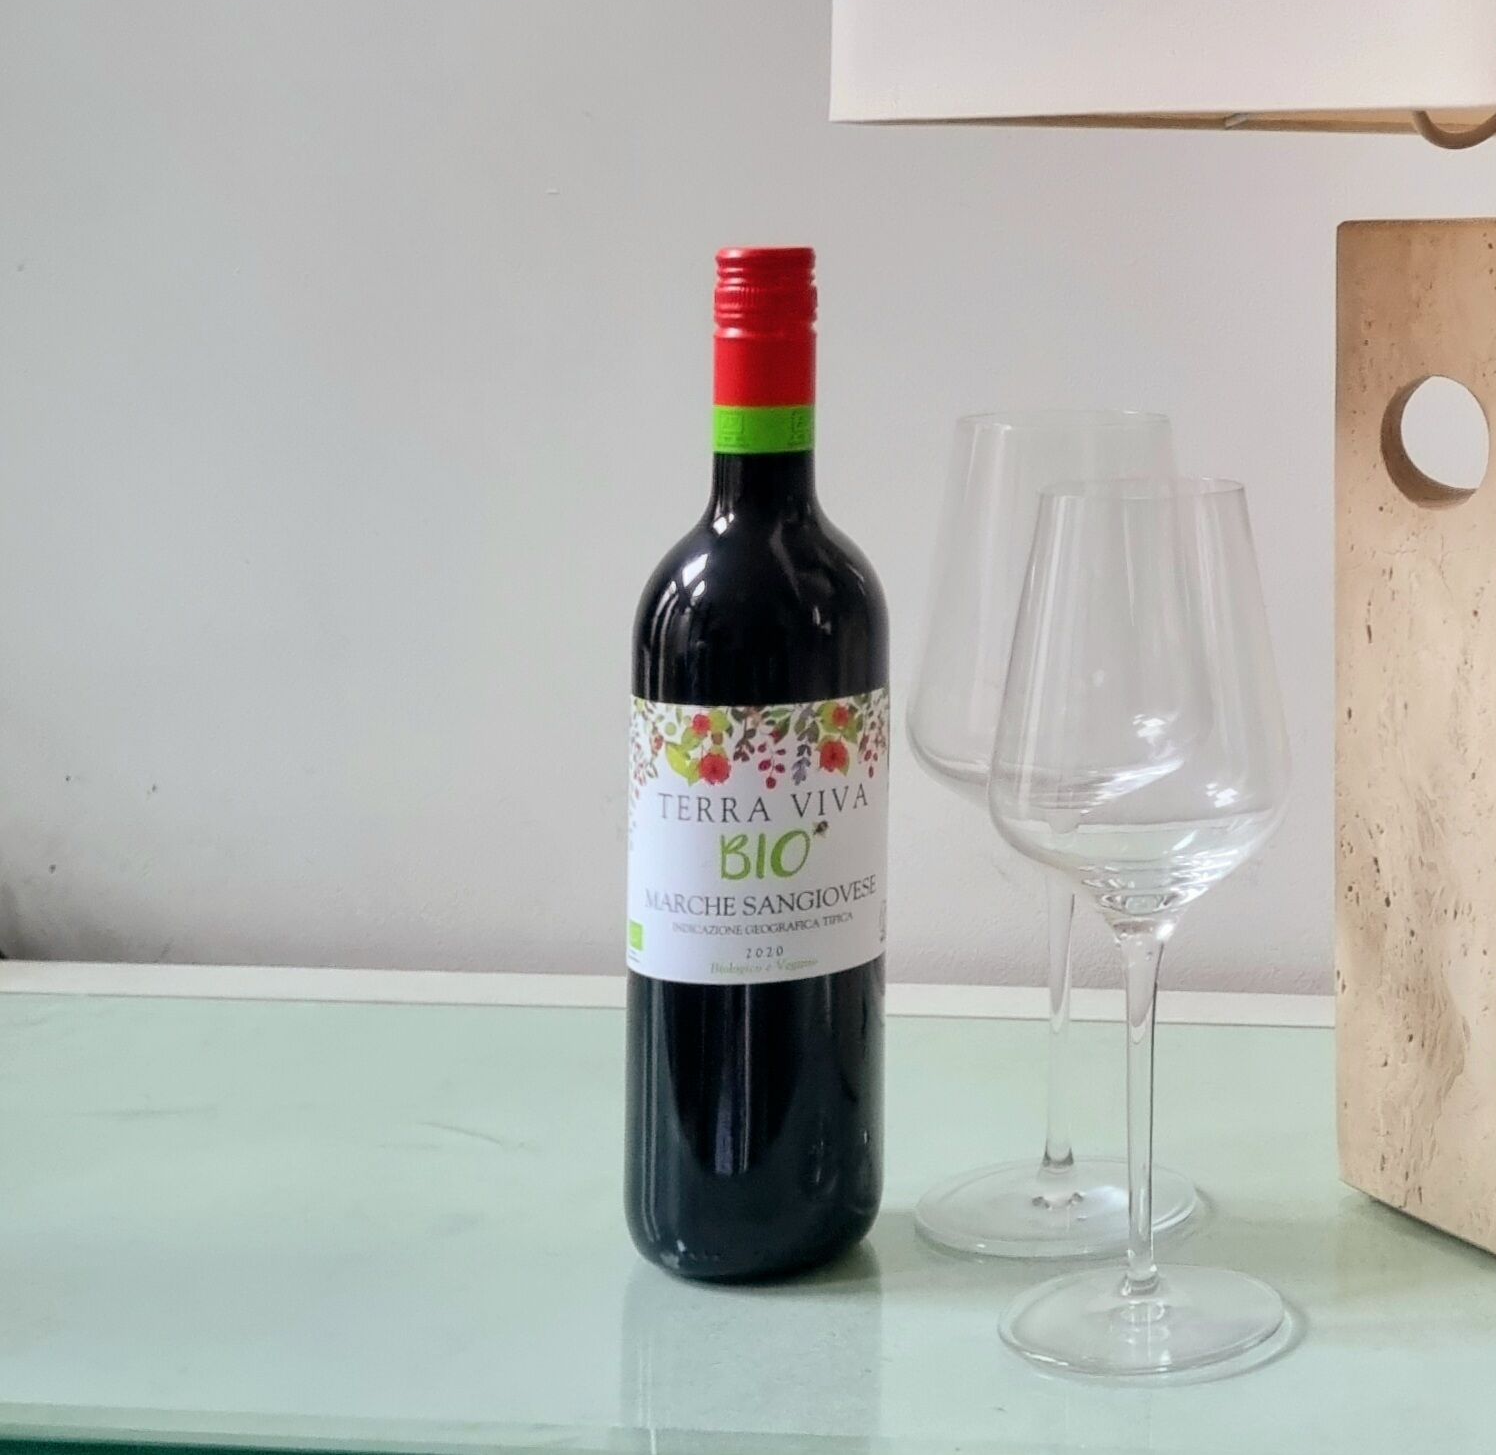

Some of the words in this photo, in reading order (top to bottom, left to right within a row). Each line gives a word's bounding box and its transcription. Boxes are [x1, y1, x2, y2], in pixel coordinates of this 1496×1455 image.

[658, 792, 771, 823] TERRA
[790, 783, 868, 819] VIVA
[719, 829, 811, 881] BIO
[645, 888, 737, 917] MARCHE
[742, 874, 877, 917] SANGIOVESE
[745, 919, 820, 936] GEOGRAFICA
[745, 945, 784, 959] 2020
